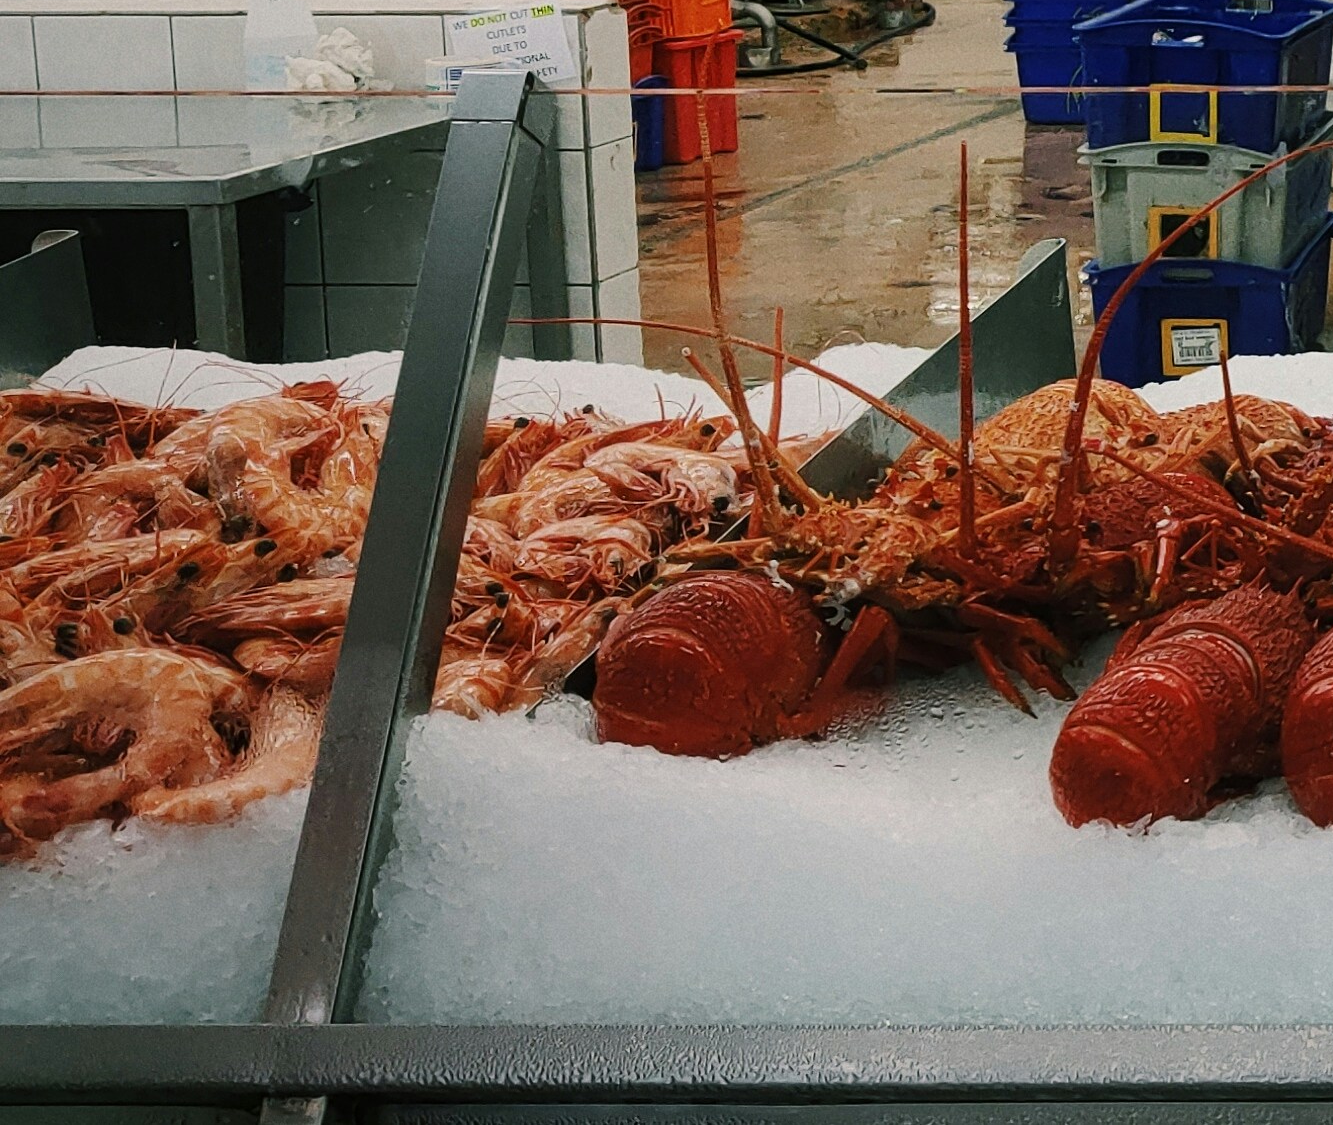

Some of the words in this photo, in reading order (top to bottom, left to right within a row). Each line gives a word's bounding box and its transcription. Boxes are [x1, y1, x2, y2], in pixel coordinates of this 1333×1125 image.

[453, 20, 468, 31] WE
[470, 17, 486, 28] DO
[487, 13, 507, 24] NOT
[510, 9, 528, 20] CUT
[531, 4, 555, 17] THIN
[486, 25, 527, 40] CUTLETS
[492, 42, 513, 54] DUE
[514, 40, 528, 51] TO
